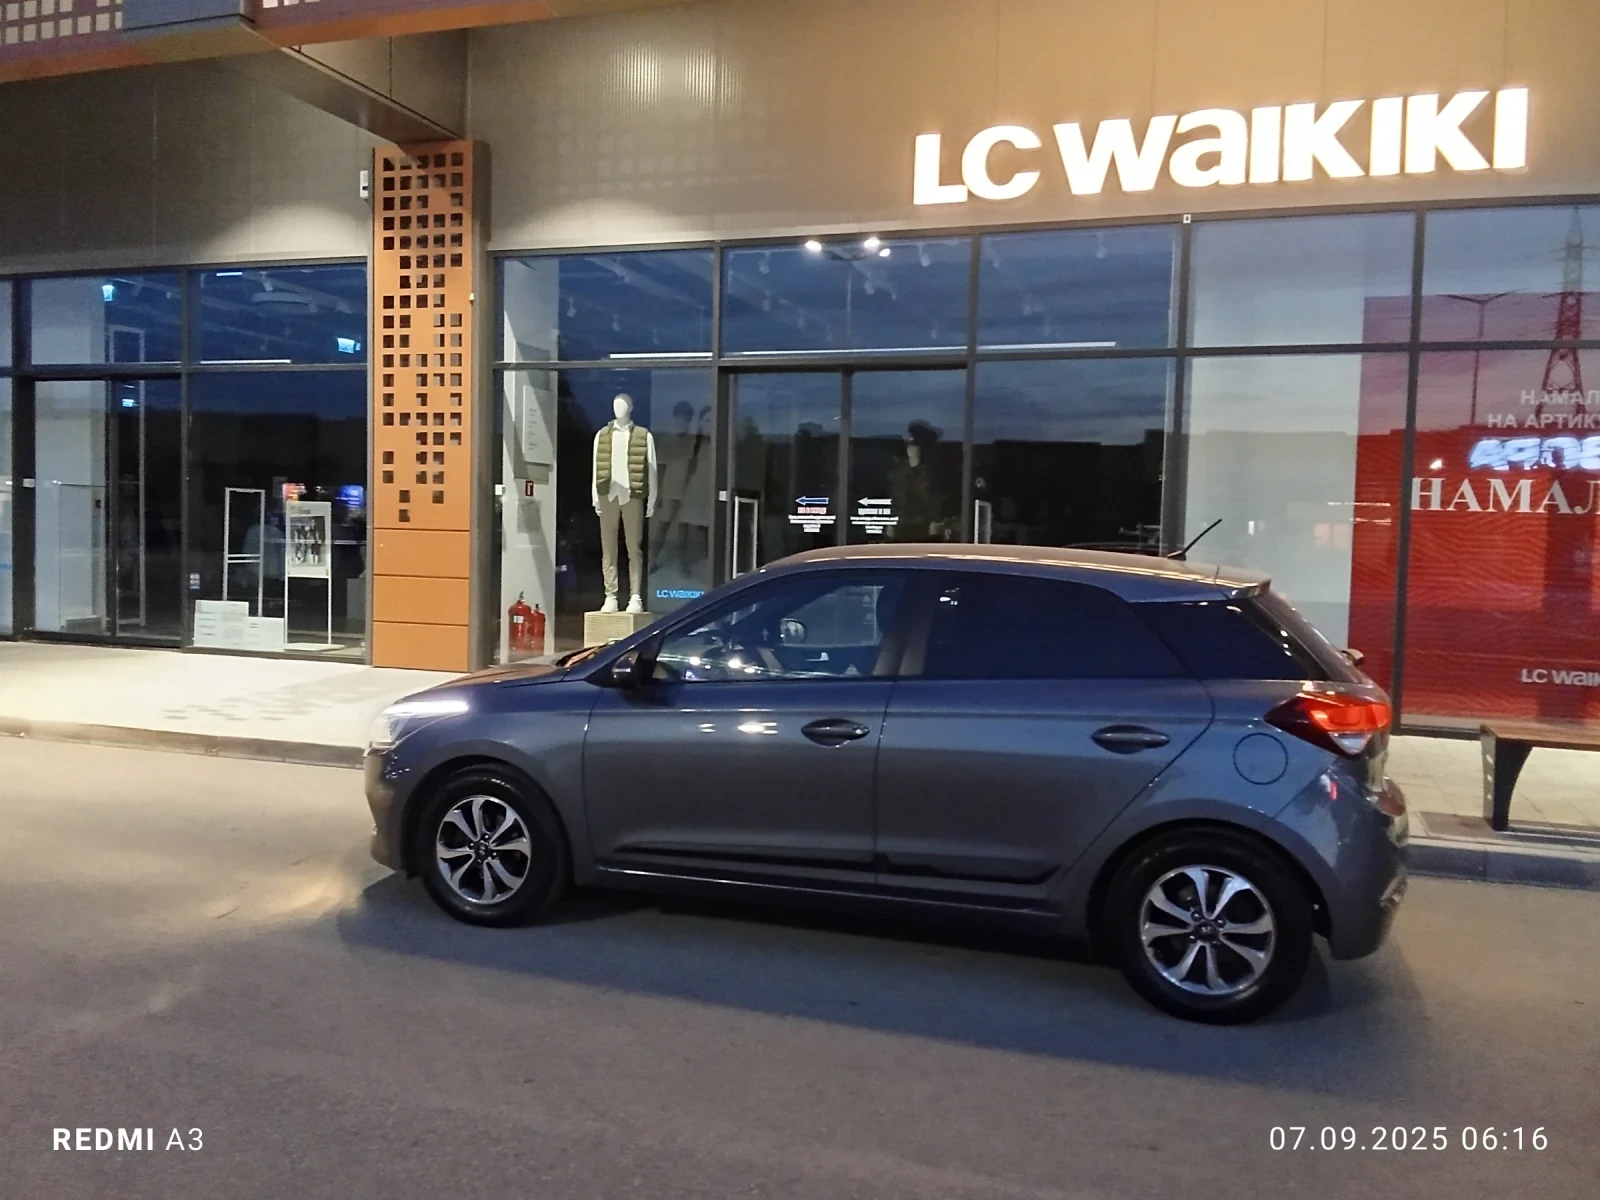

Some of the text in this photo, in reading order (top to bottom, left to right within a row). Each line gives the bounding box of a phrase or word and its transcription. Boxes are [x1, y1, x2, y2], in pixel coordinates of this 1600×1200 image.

[913, 125, 1042, 205] LC
[1487, 413, 1517, 428] НА
[1521, 668, 1548, 683] LC
